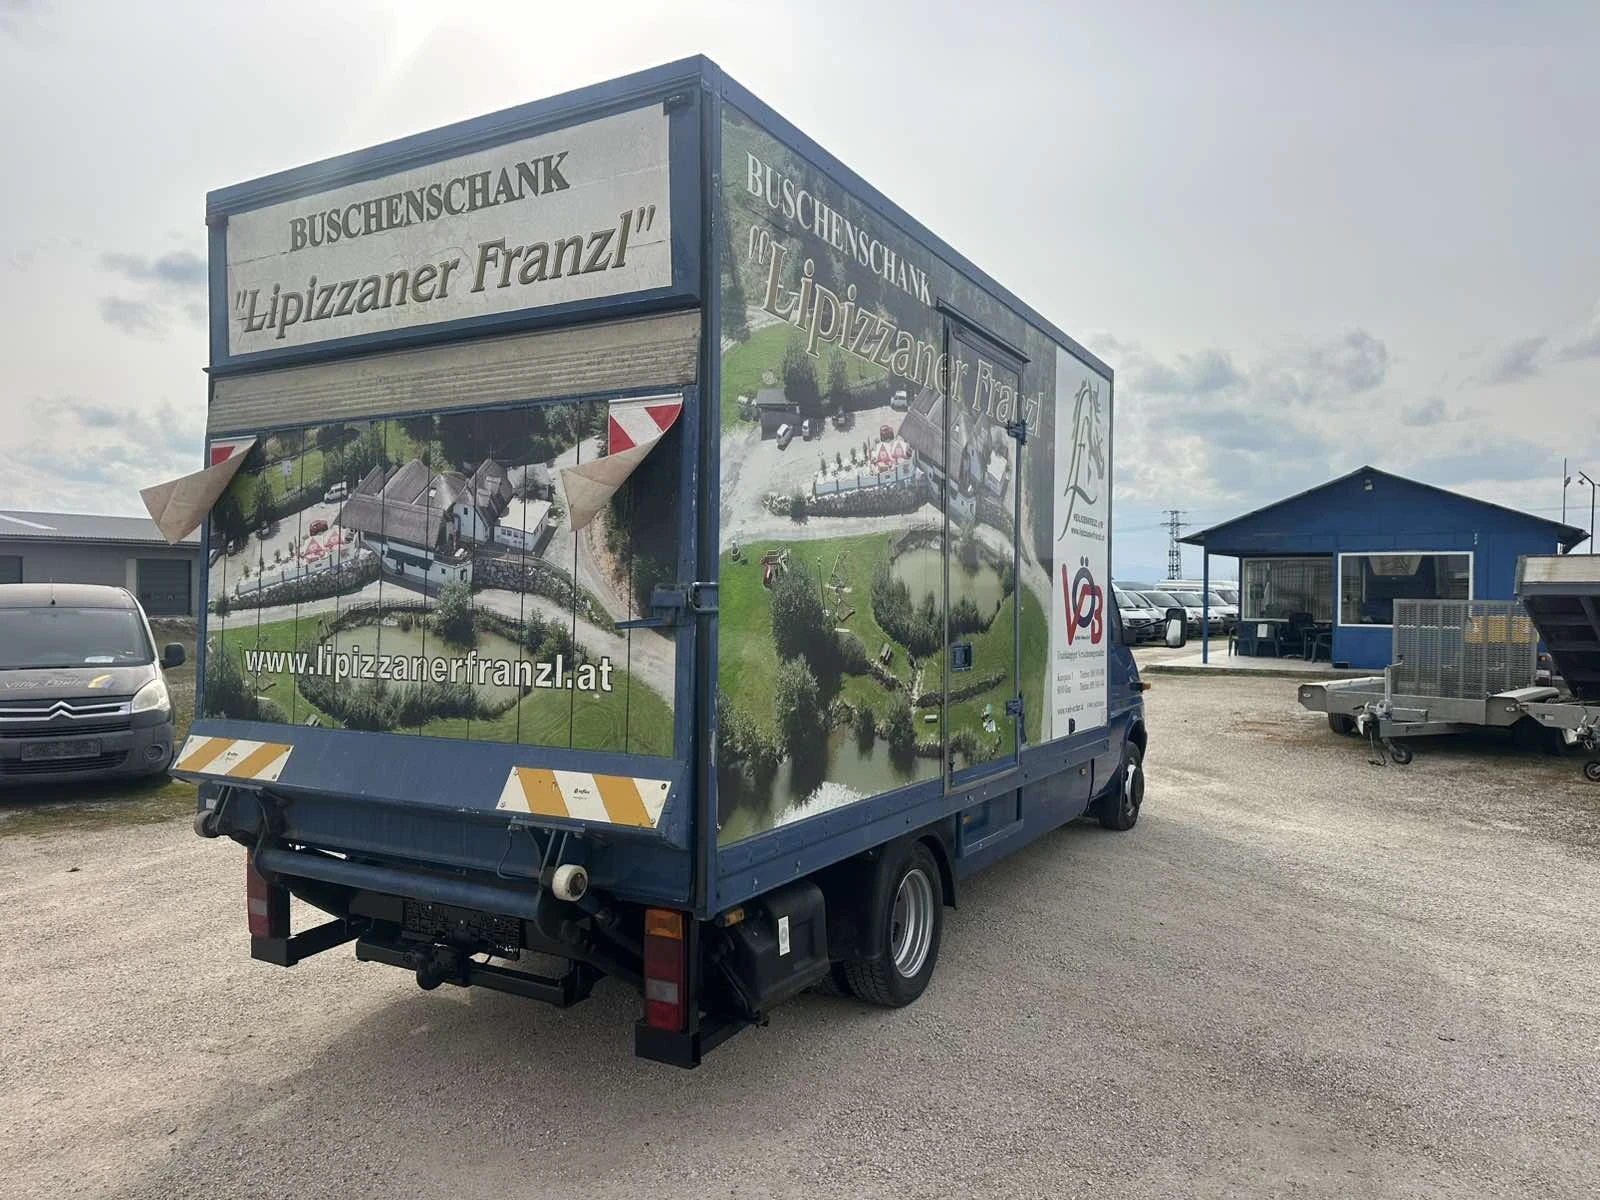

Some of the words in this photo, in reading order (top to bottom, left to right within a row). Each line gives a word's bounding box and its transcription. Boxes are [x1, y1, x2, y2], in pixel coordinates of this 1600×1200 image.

[289, 151, 570, 252] BUSCHENSCHANK
[745, 152, 932, 306] BUSCHENSCHANK
[235, 258, 460, 339] "Lipizzaner
[471, 205, 656, 293] Franzl"
[243, 644, 614, 692] www.lipizzanerfranzl.at
